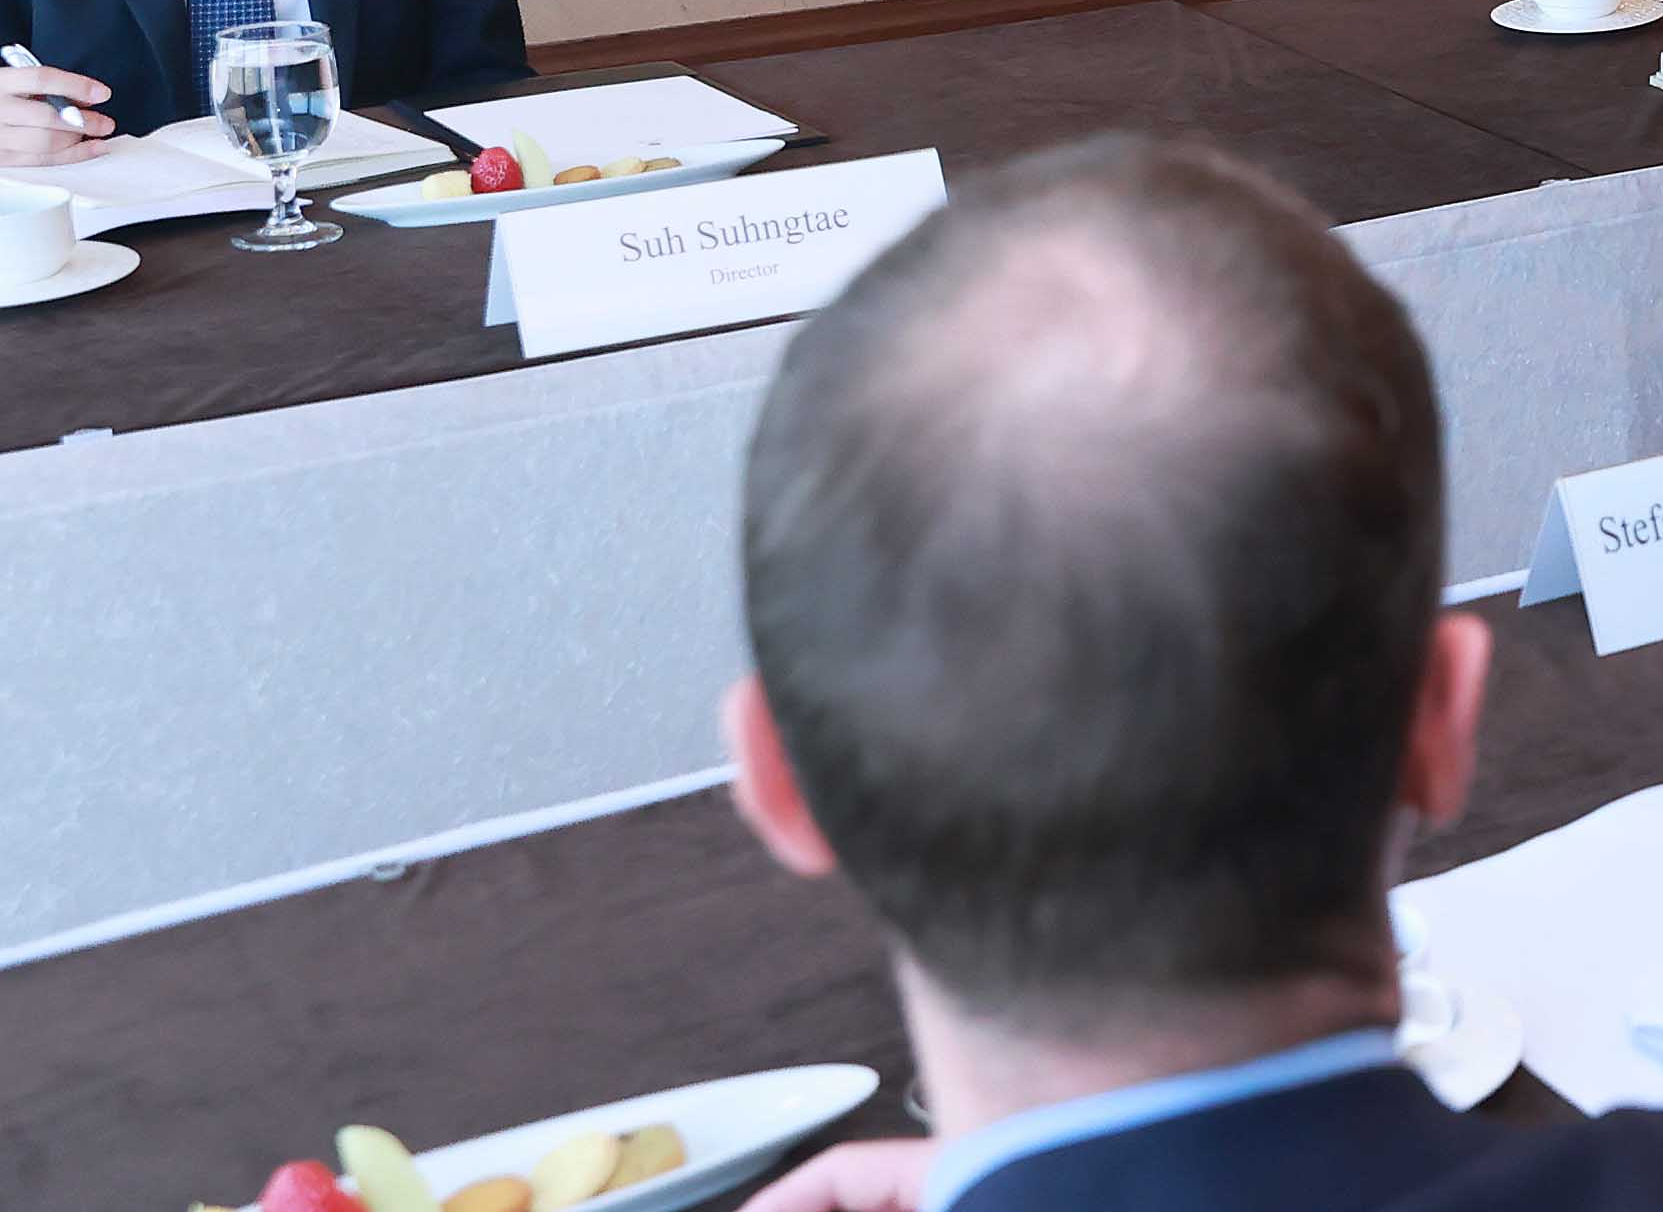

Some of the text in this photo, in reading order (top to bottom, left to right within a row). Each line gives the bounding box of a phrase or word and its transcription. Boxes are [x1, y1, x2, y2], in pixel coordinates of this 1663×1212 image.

[619, 207, 851, 262] Suh Suhngtae
[709, 262, 780, 285] Director
